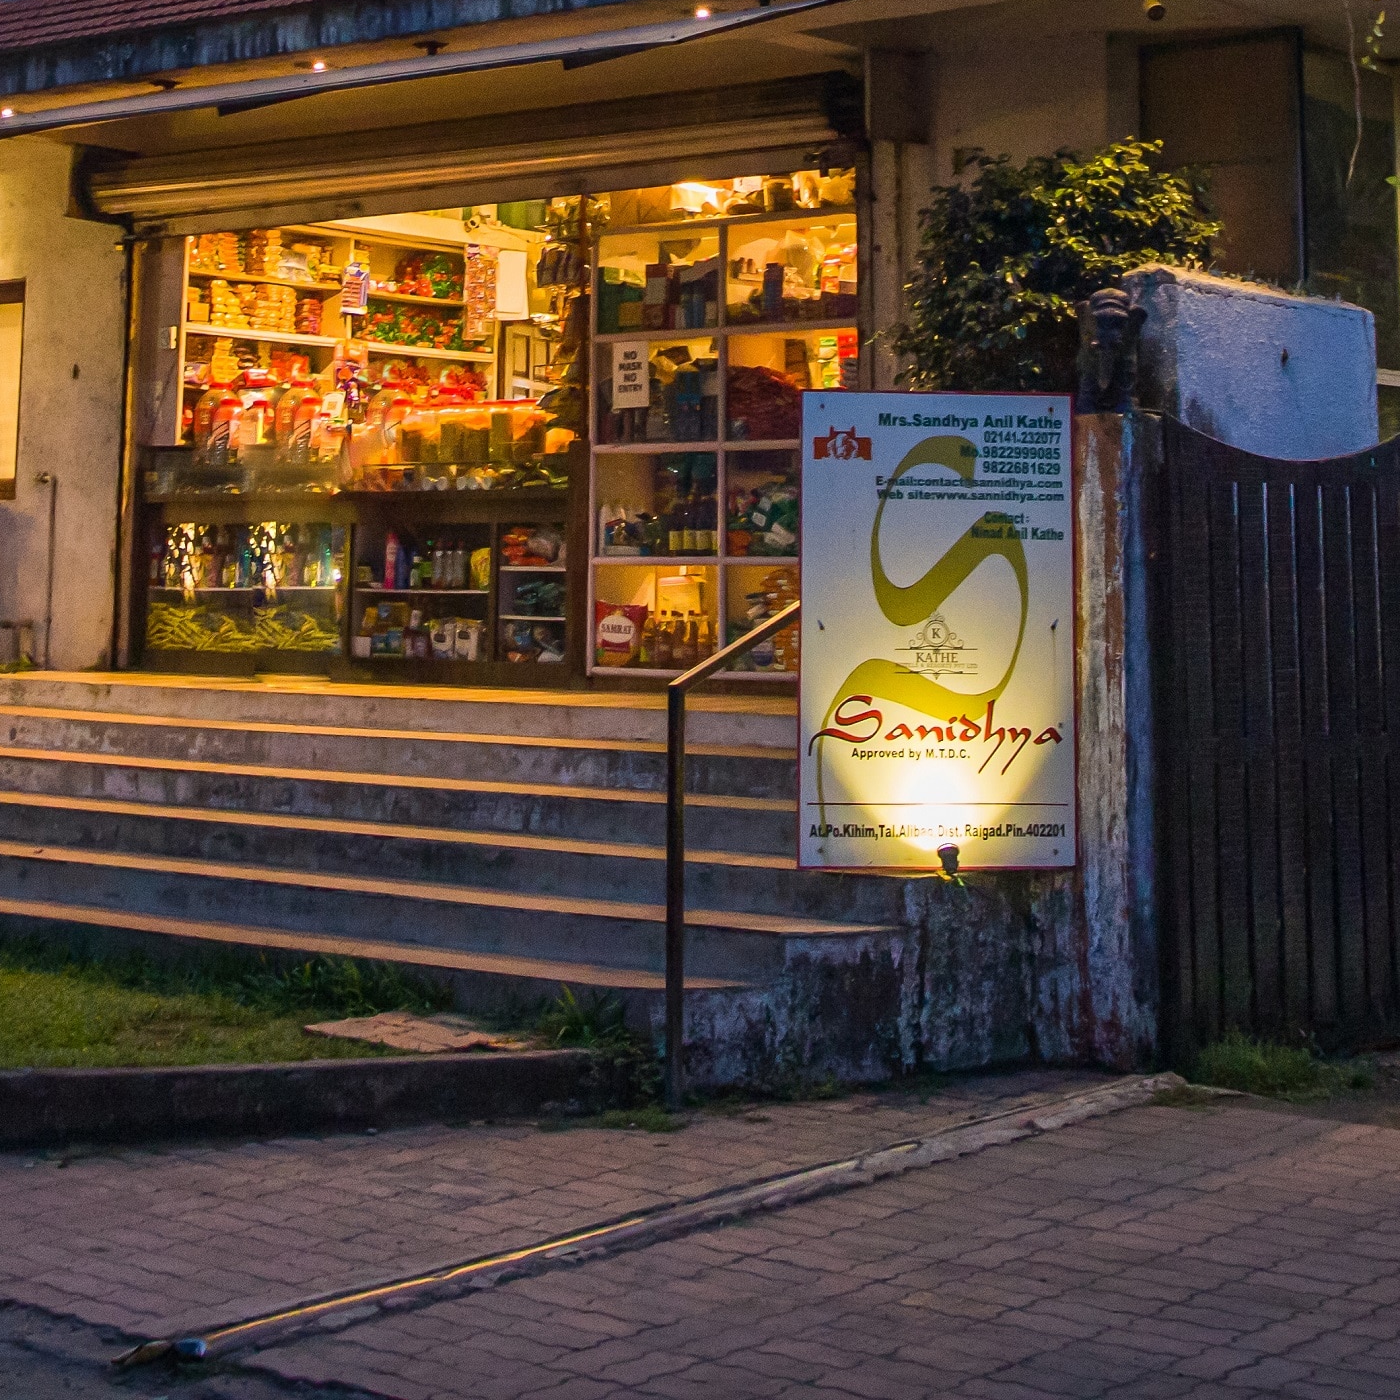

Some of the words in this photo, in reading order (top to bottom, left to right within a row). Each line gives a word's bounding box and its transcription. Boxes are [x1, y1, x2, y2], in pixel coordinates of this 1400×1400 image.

[623, 351, 637, 360] NO
[618, 362, 642, 371] MASK
[623, 373, 637, 382] NO
[878, 412, 979, 431] Mrs.Sandhya
[983, 415, 1013, 428] Anil
[1017, 415, 1063, 429] Kathe
[983, 461, 1060, 475] 9822681629
[877, 489, 904, 500] Web
[1007, 526, 1028, 539] Anil
[1031, 526, 1065, 540] Kathe
[931, 628, 941, 639] K
[916, 652, 959, 663] KATHE
[808, 694, 1063, 775] Sanidhya
[851, 747, 905, 761] Approved
[909, 748, 921, 760] by
[925, 748, 971, 759] M.T.D.C.
